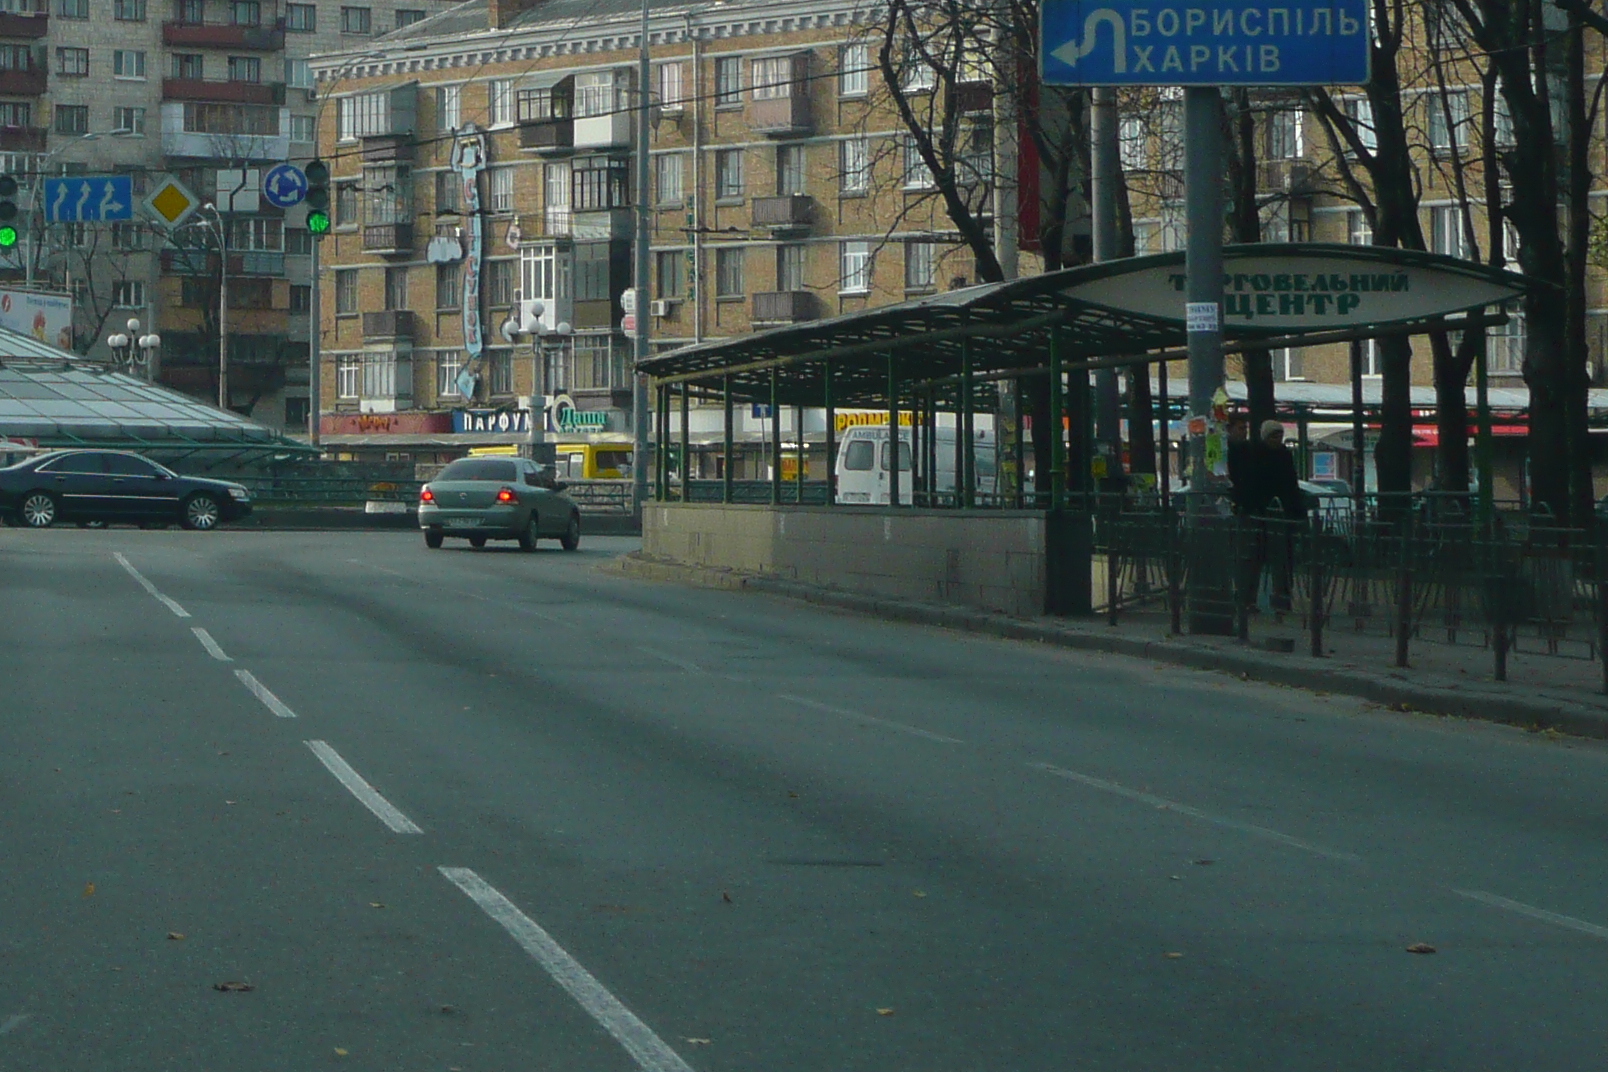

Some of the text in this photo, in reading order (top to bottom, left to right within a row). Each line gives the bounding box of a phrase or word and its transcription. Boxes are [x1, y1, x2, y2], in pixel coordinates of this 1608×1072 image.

[1131, 8, 1360, 37] БОРИСПІЛЬ
[1133, 45, 1280, 73] ХАРКІВ
[1225, 293, 1361, 320] ЦЕНТР
